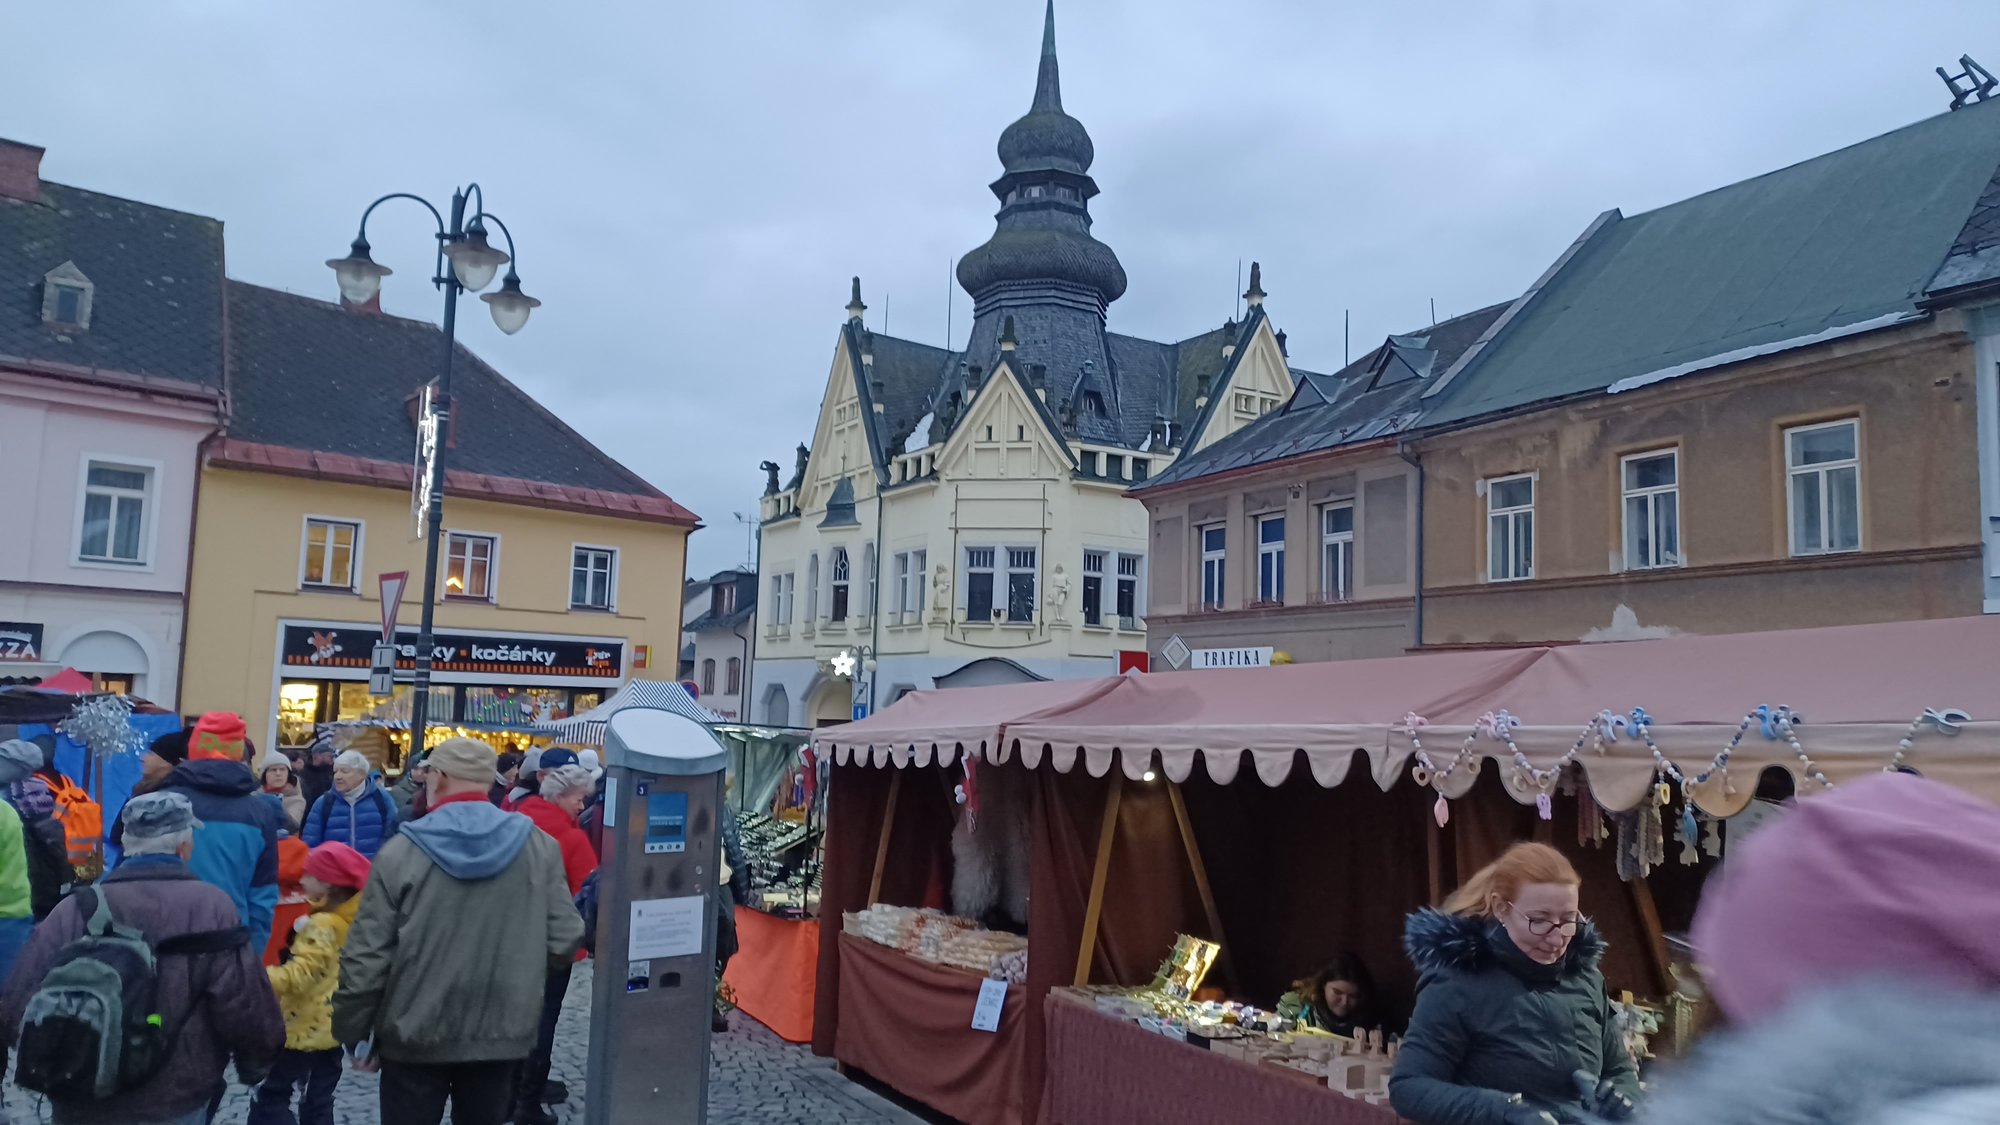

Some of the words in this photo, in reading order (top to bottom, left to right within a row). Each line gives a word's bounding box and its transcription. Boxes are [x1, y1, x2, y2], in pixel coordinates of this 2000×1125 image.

[0, 641, 36, 658] ZA
[471, 644, 555, 666] kočárky
[1203, 650, 1260, 666] TRAFIKA
